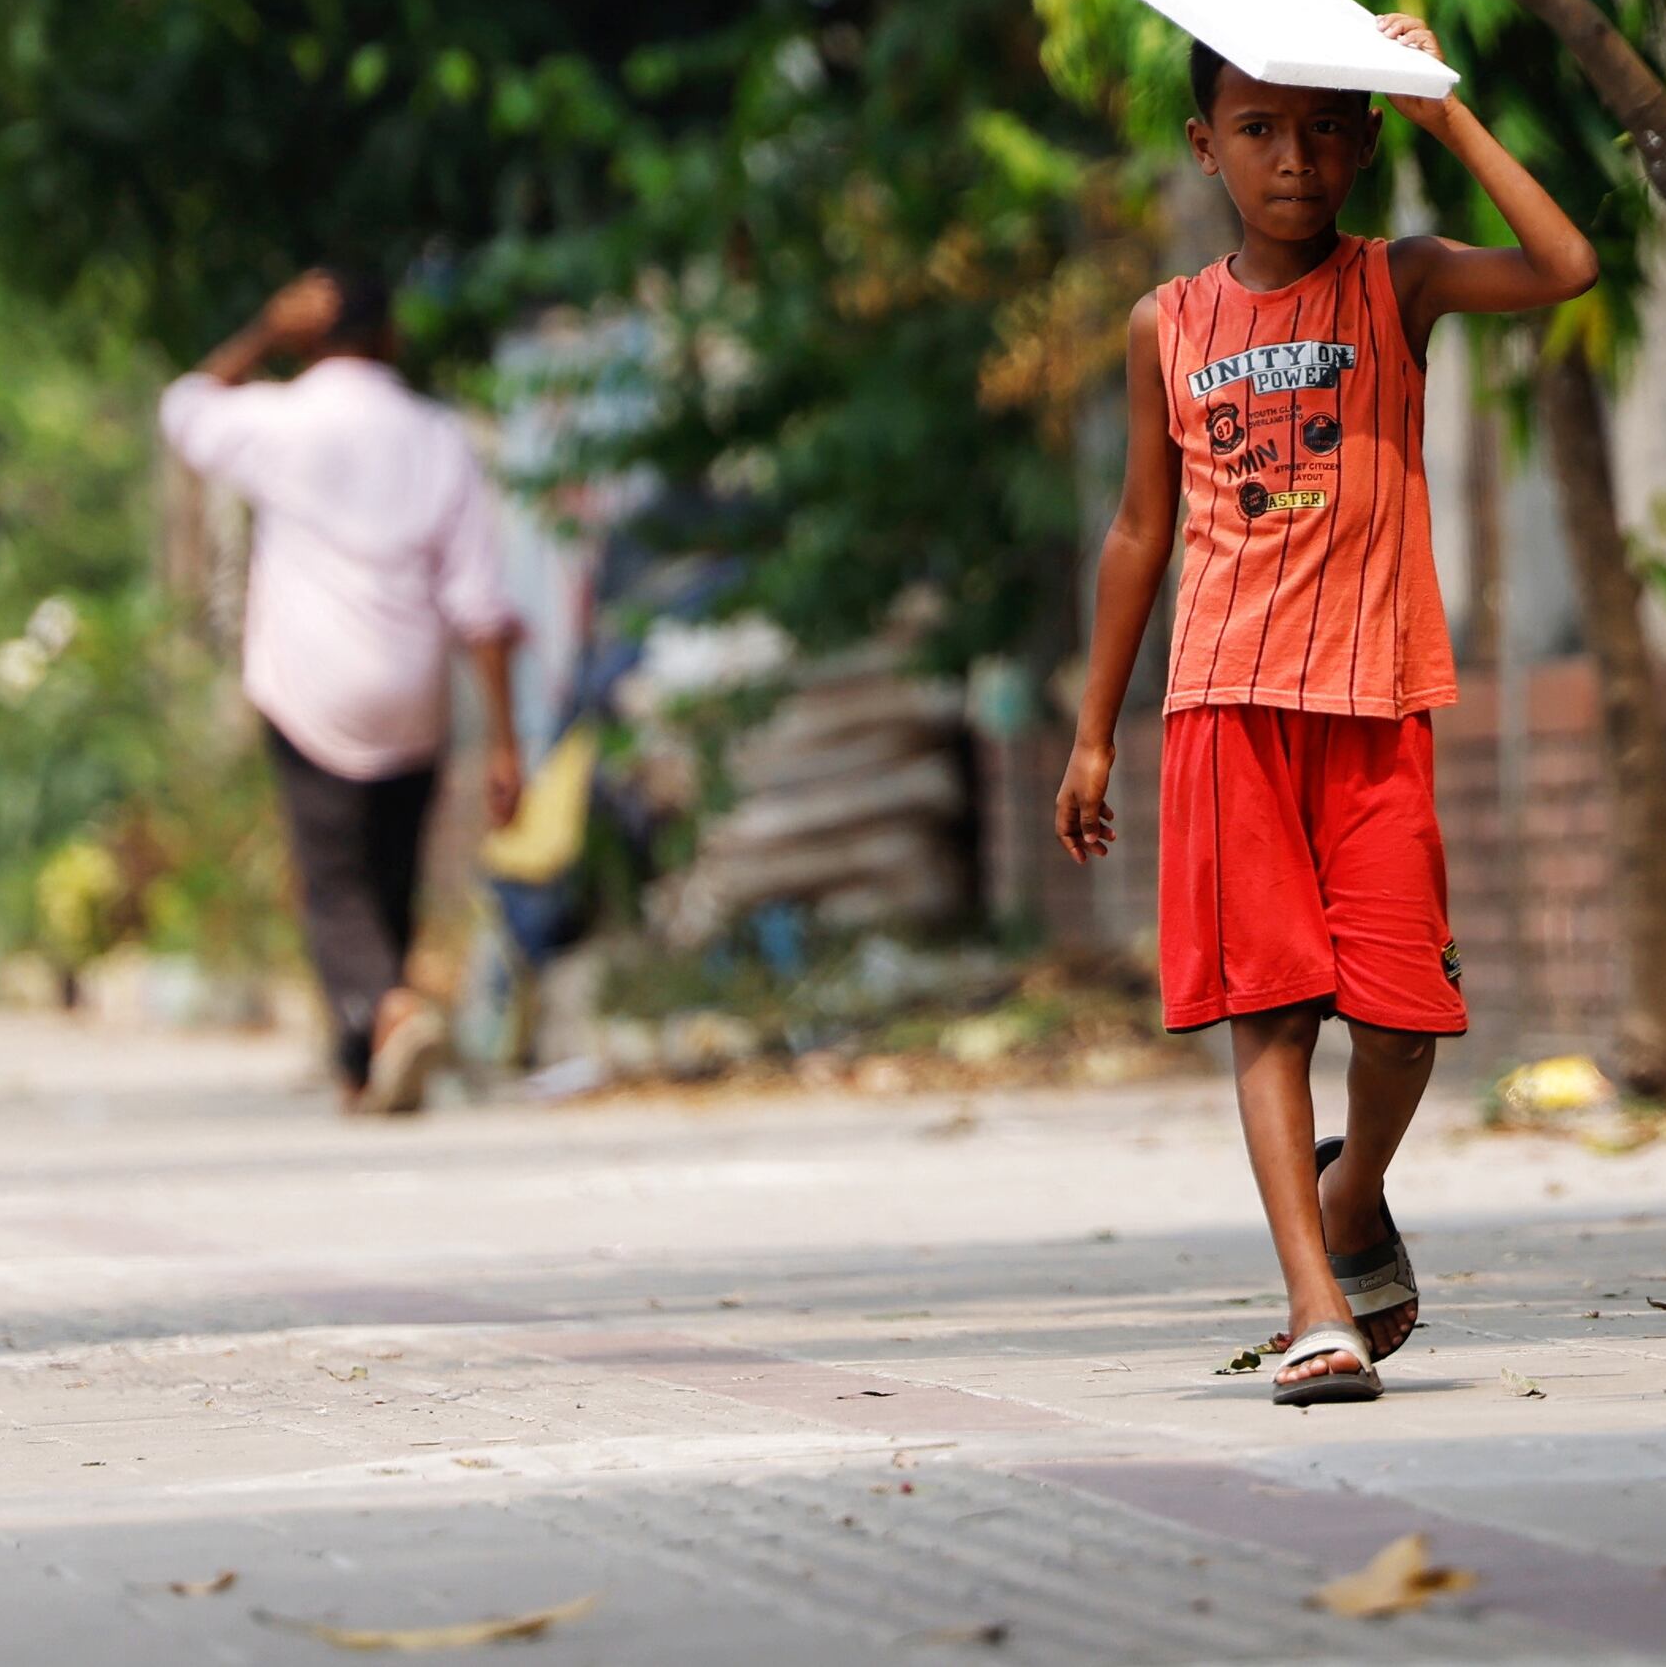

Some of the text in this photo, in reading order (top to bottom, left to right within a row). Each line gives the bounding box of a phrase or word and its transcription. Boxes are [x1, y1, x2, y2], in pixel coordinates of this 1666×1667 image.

[1193, 344, 1306, 392] UNITY
[1248, 407, 1277, 419] YOUTH
[1216, 420, 1231, 439] 87
[1309, 462, 1340, 471] CITIZEN
[1268, 492, 1321, 509] ASTER
